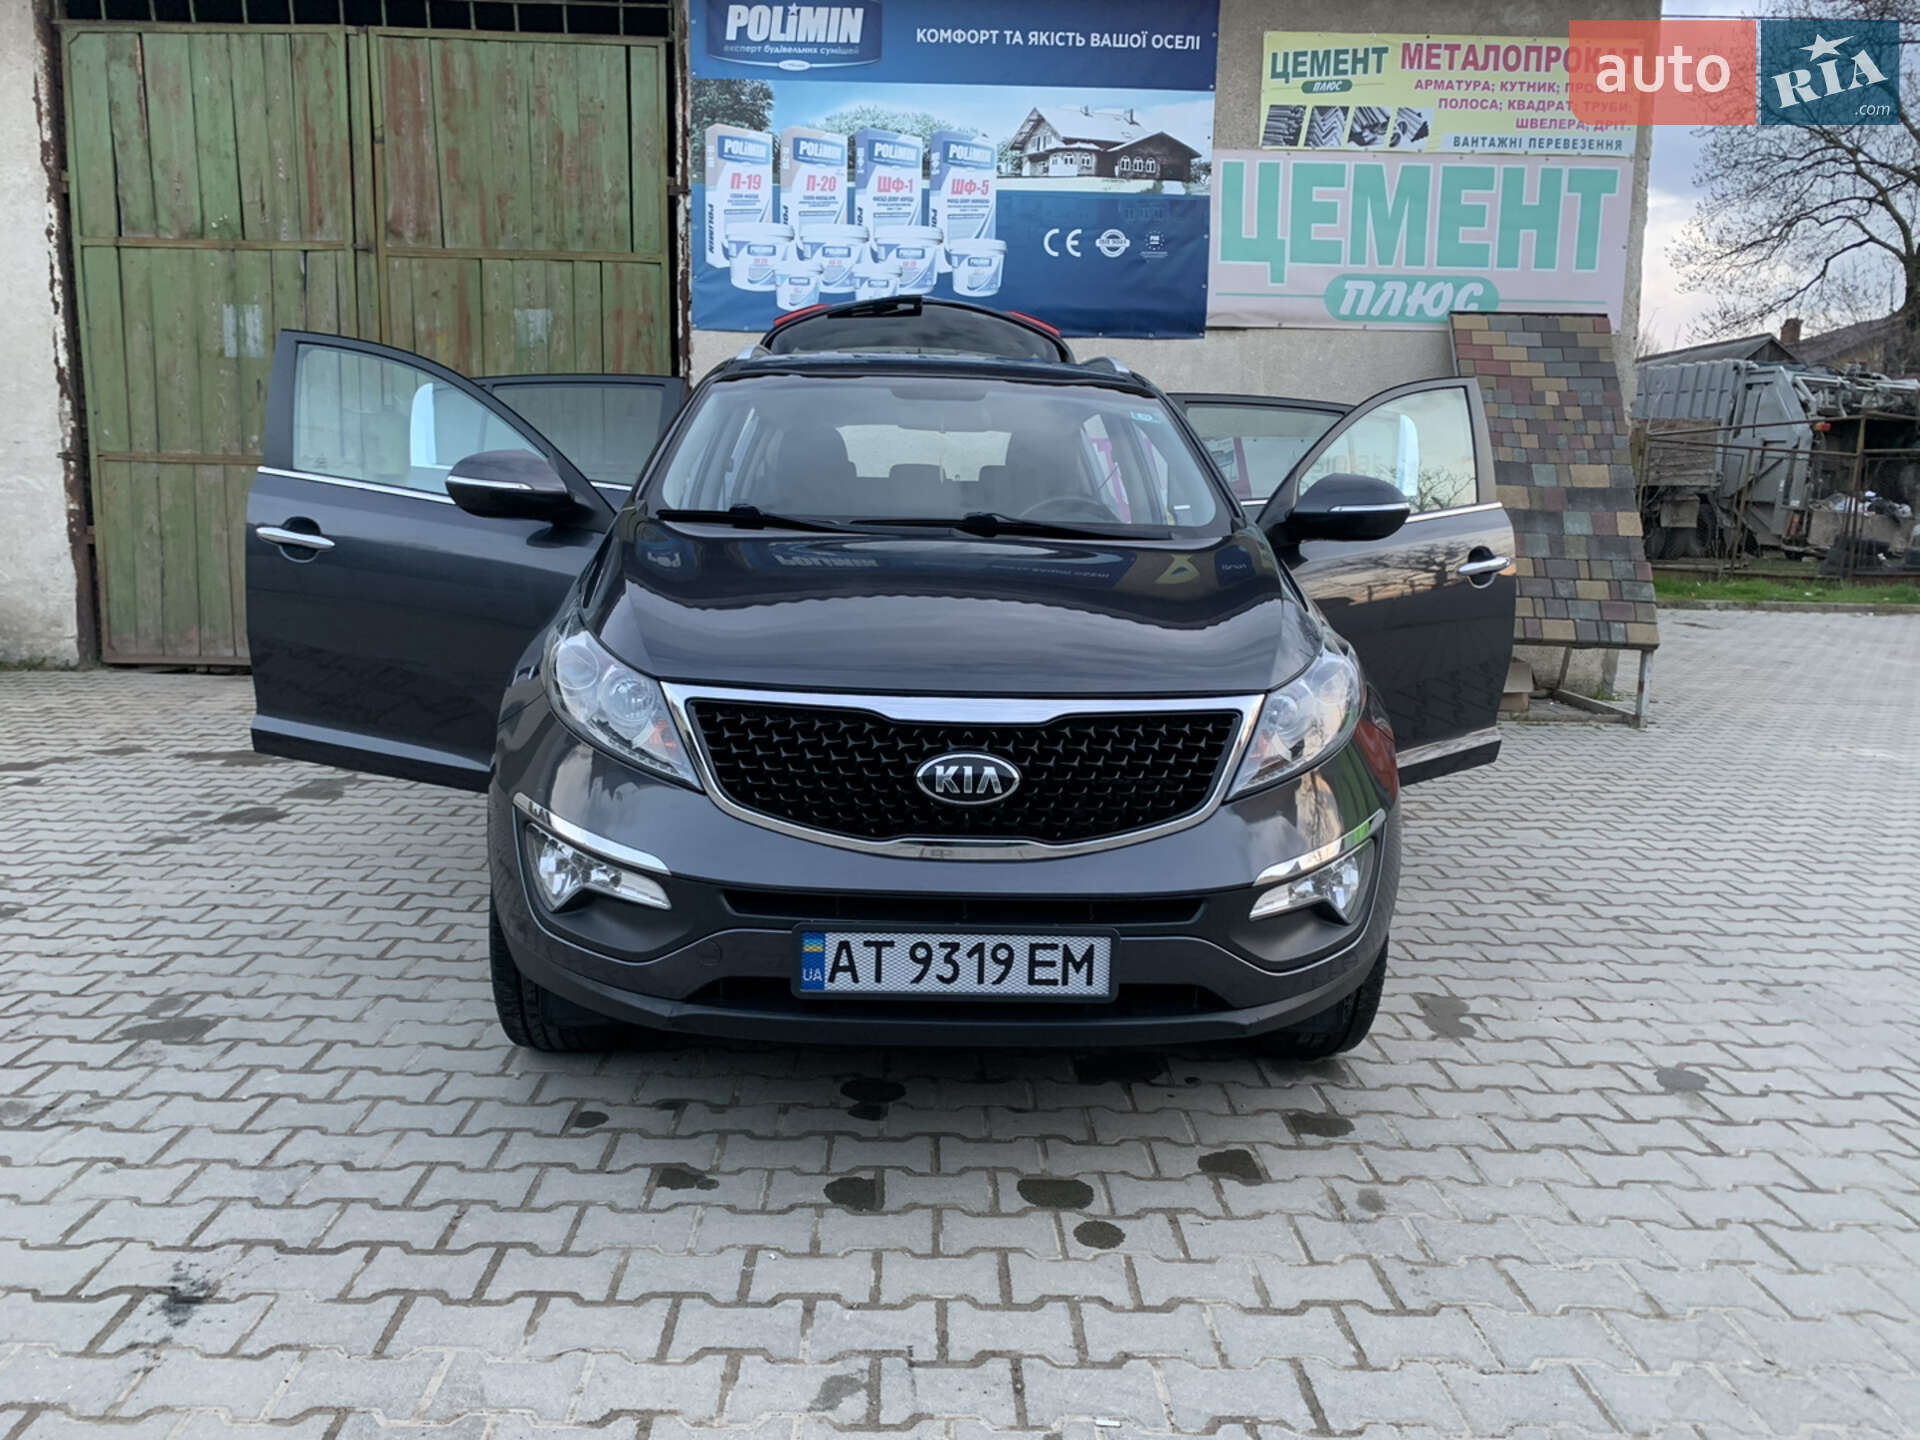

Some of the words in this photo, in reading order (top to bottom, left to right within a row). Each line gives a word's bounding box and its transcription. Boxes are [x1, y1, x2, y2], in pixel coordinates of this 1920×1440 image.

[916, 28, 999, 45] КОМФОРТ
[1003, 30, 1024, 46] ТА
[1028, 31, 1086, 47] ЯКІСТЬ
[1090, 30, 1148, 48] ВАШОЇ
[1151, 34, 1200, 50] ОСЕЛІ
[1270, 46, 1389, 84] ЦЕМЕНТ
[1312, 81, 1343, 92] ПЛЮС
[1414, 79, 1496, 93] АРМАТУРА;
[1500, 81, 1560, 95] КУТНИК;
[1438, 98, 1503, 112] ПОЛОСА;
[1453, 135, 1522, 148] ВАНТАЖНІ
[1528, 137, 1623, 150] ПЕРЕВЕЗЕННЯ
[730, 172, 762, 190] П-19
[806, 174, 837, 192] П-20
[877, 175, 913, 193] ШФ-1
[951, 178, 989, 196] ШФ-5
[1218, 160, 1620, 286] ЦЕМЕНТ
[1338, 279, 1485, 317] ПЛЮС
[934, 765, 1003, 795] KIA
[828, 940, 895, 984] AT
[909, 941, 1015, 985] 9319
[1027, 943, 1095, 987] EM
[802, 967, 823, 982] UA
